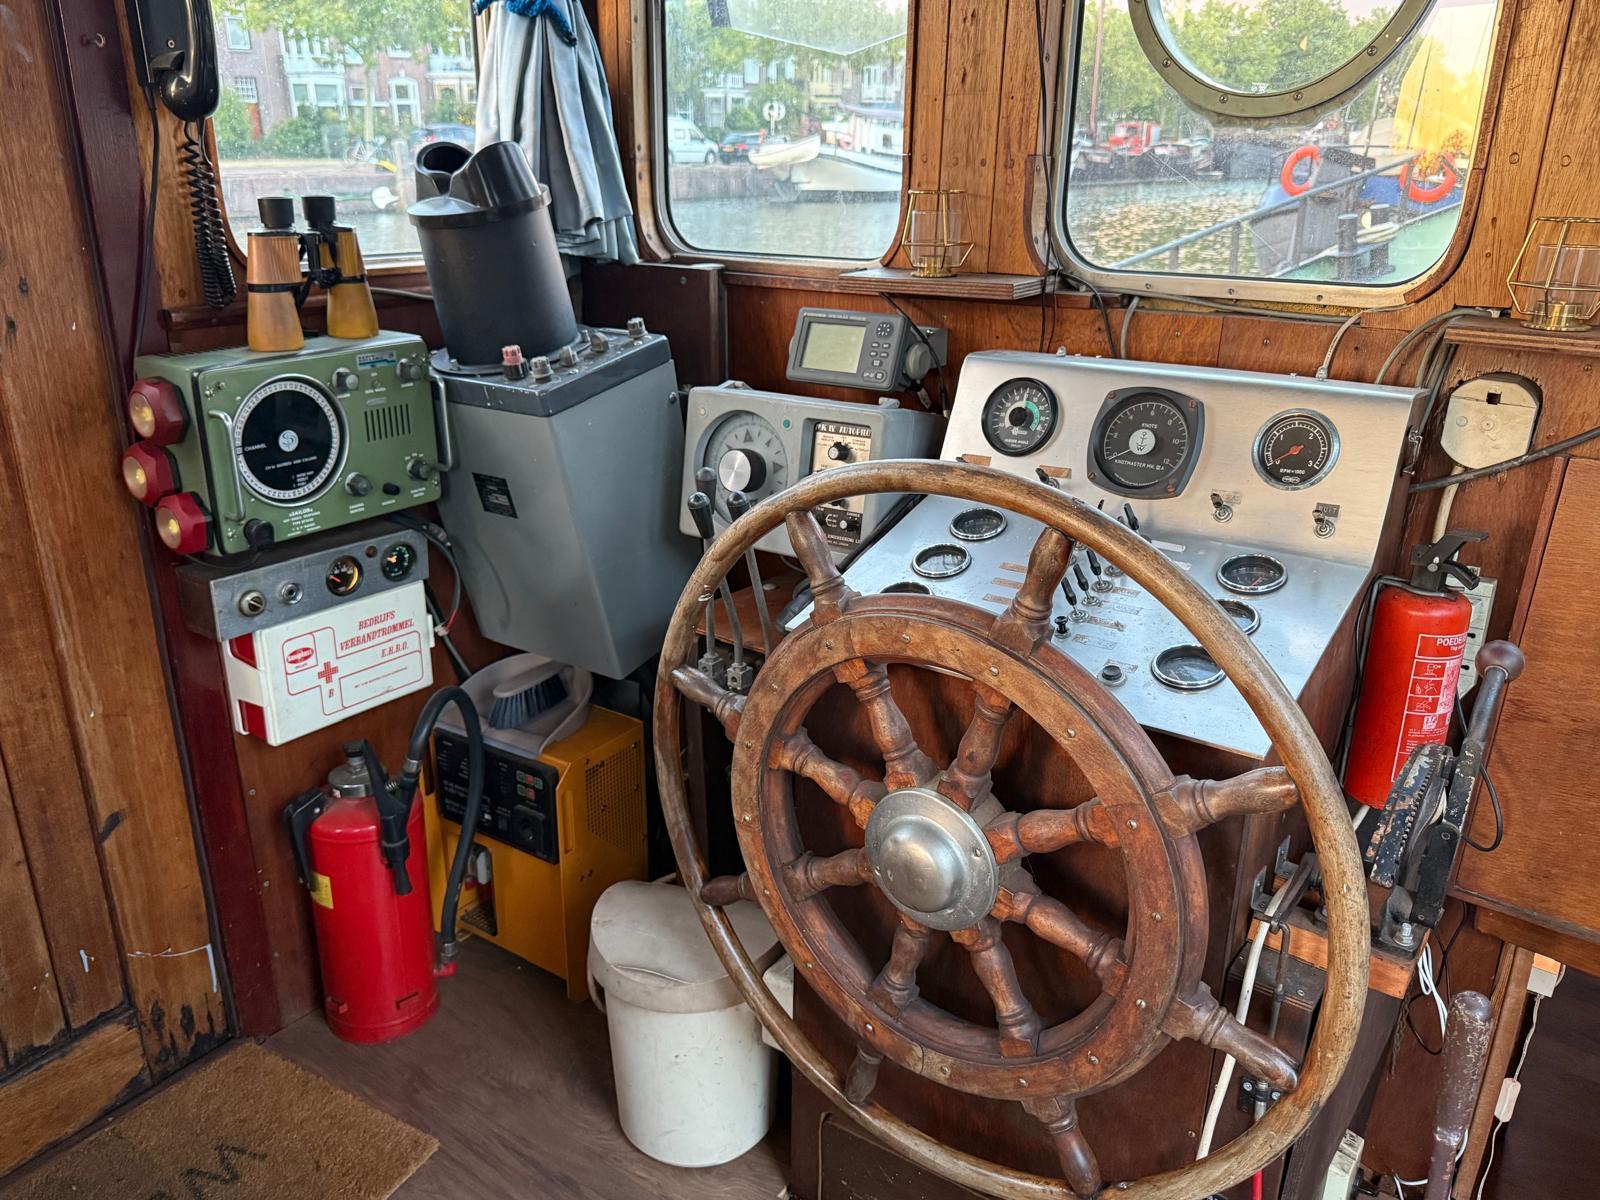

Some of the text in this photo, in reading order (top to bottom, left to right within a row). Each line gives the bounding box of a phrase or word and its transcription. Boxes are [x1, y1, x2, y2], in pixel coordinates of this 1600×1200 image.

[244, 443, 267, 452] CHANNEL
[1114, 459, 1146, 468] KNOTMASTER
[358, 610, 395, 630] BEDRIJFS
[340, 618, 415, 651] VERBANDTROMMEL
